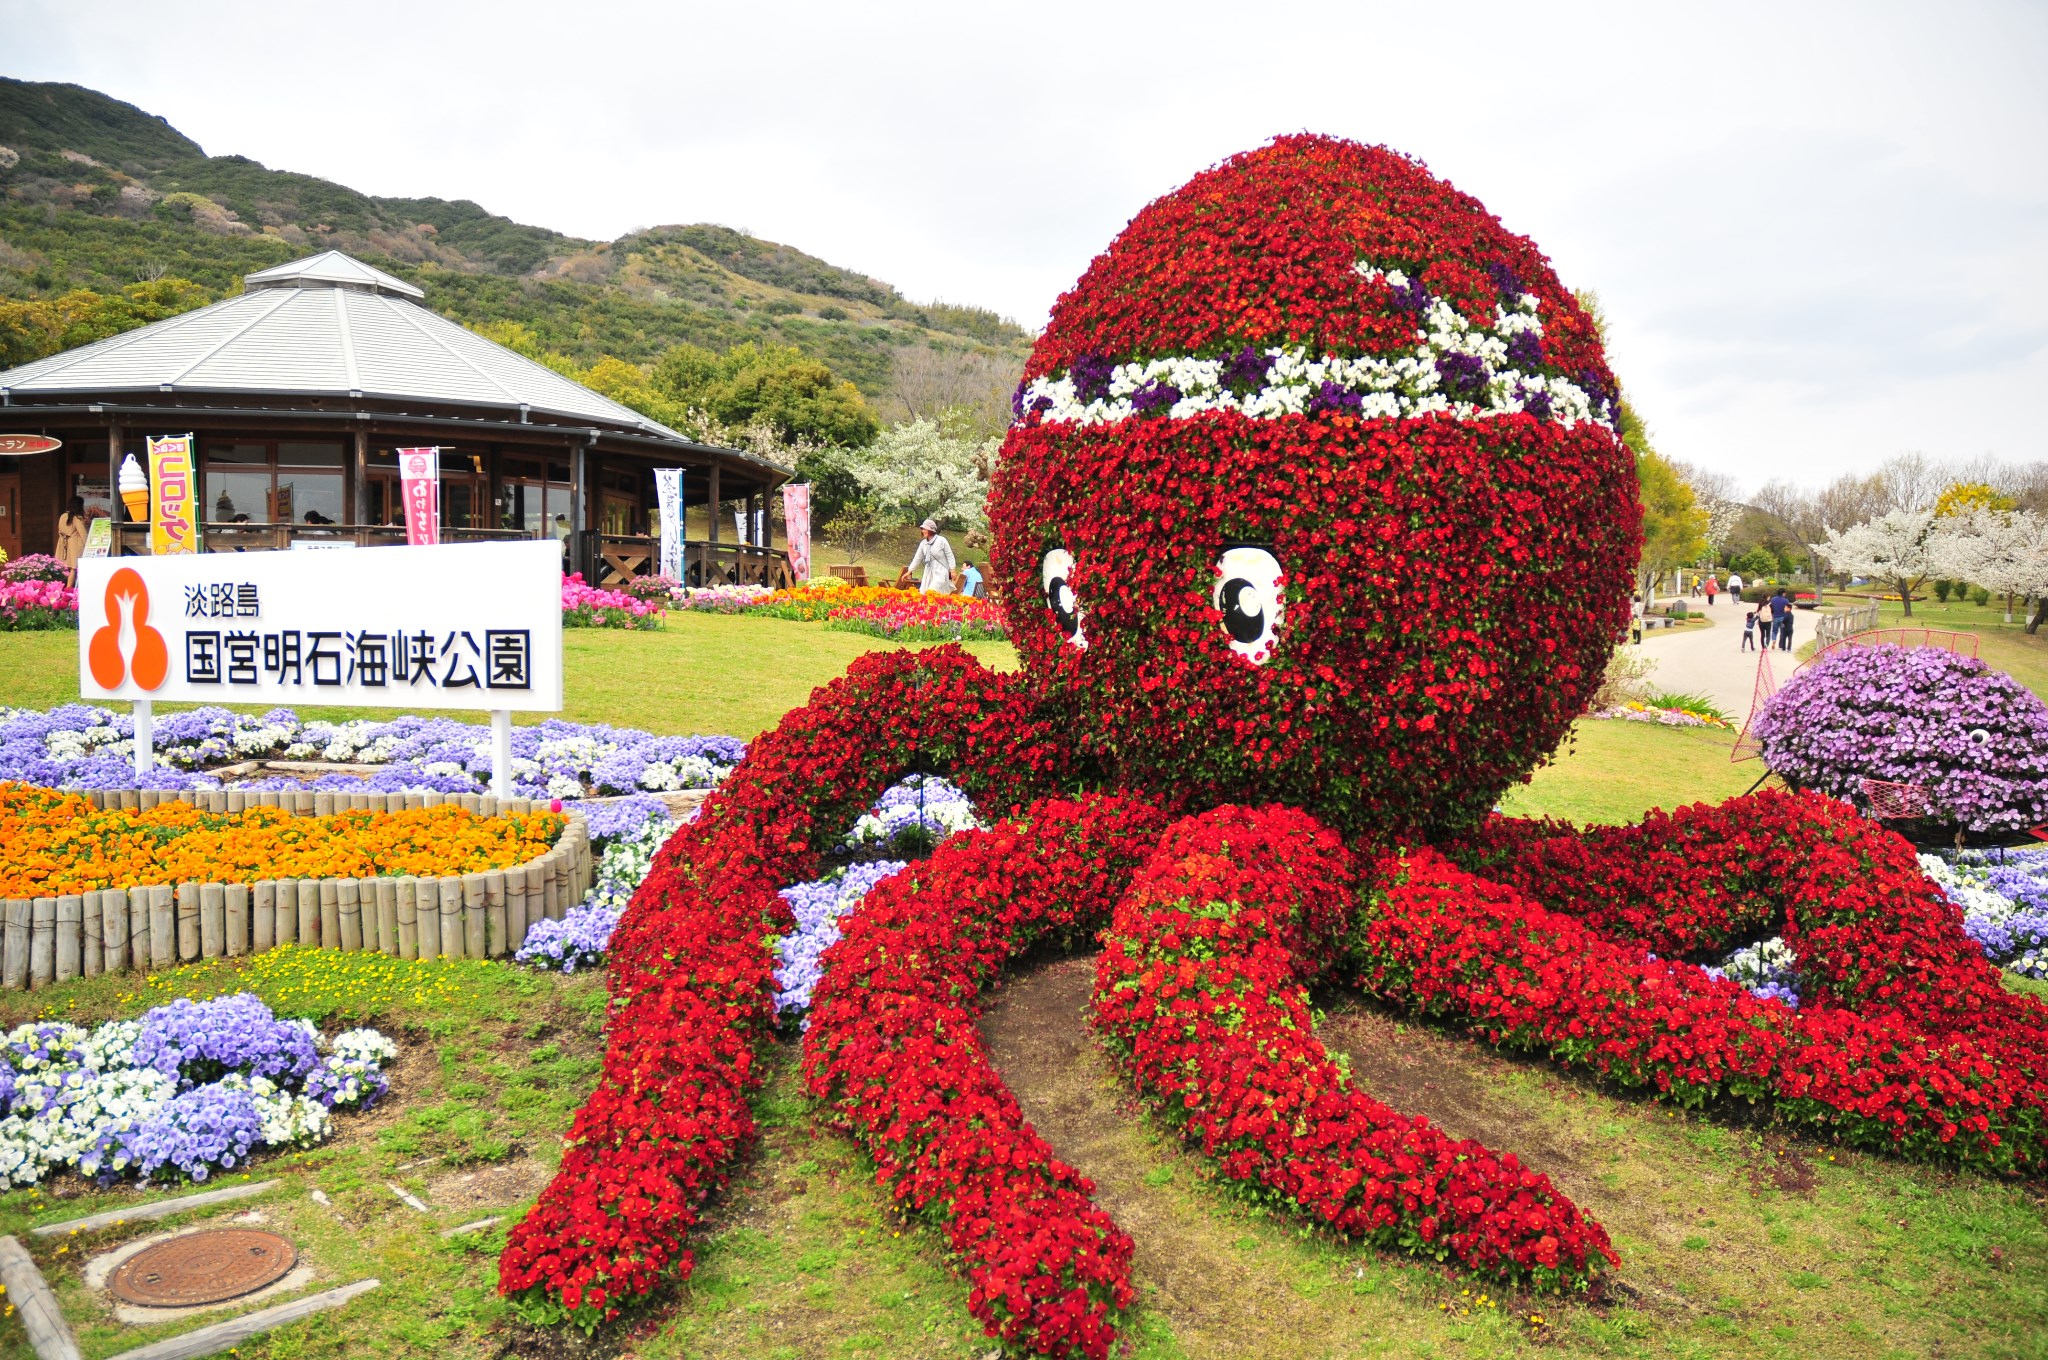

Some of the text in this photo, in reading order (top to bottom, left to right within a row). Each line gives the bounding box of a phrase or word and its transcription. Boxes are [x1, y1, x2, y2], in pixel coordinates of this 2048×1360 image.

[184, 582, 260, 618] 淡路島
[185, 629, 532, 690] 国営明石海峡公園
